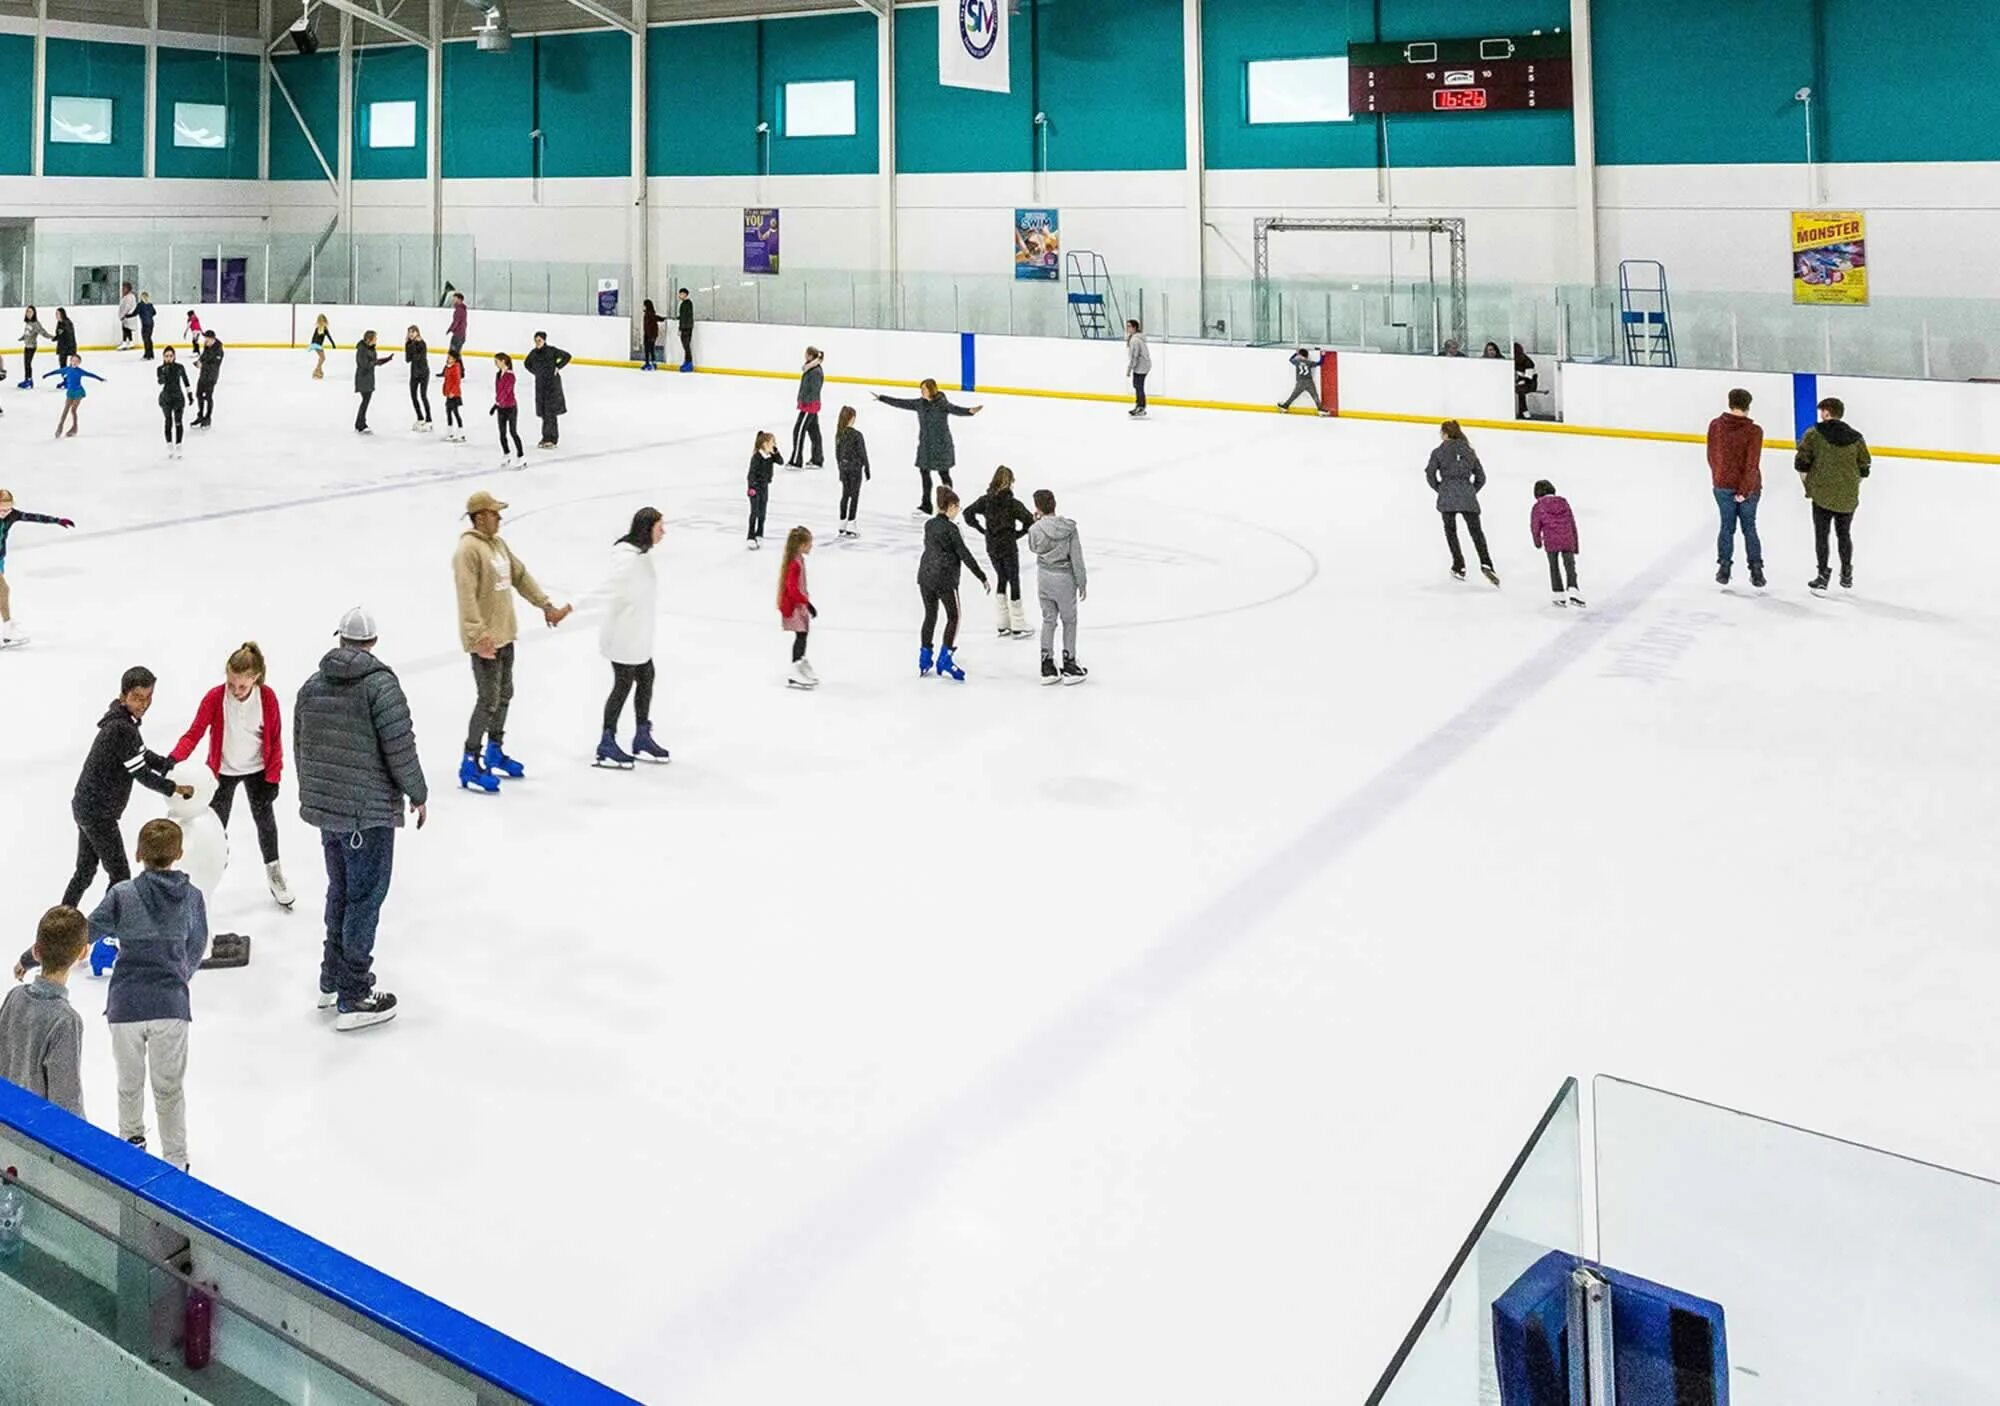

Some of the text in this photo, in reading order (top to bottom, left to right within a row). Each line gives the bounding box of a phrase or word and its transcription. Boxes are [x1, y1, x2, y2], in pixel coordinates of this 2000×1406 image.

[1441, 91, 1484, 107] 16:26
[745, 214, 764, 226] YOU
[1020, 217, 1052, 230] SWIM
[1796, 220, 1860, 243] MONSTER
